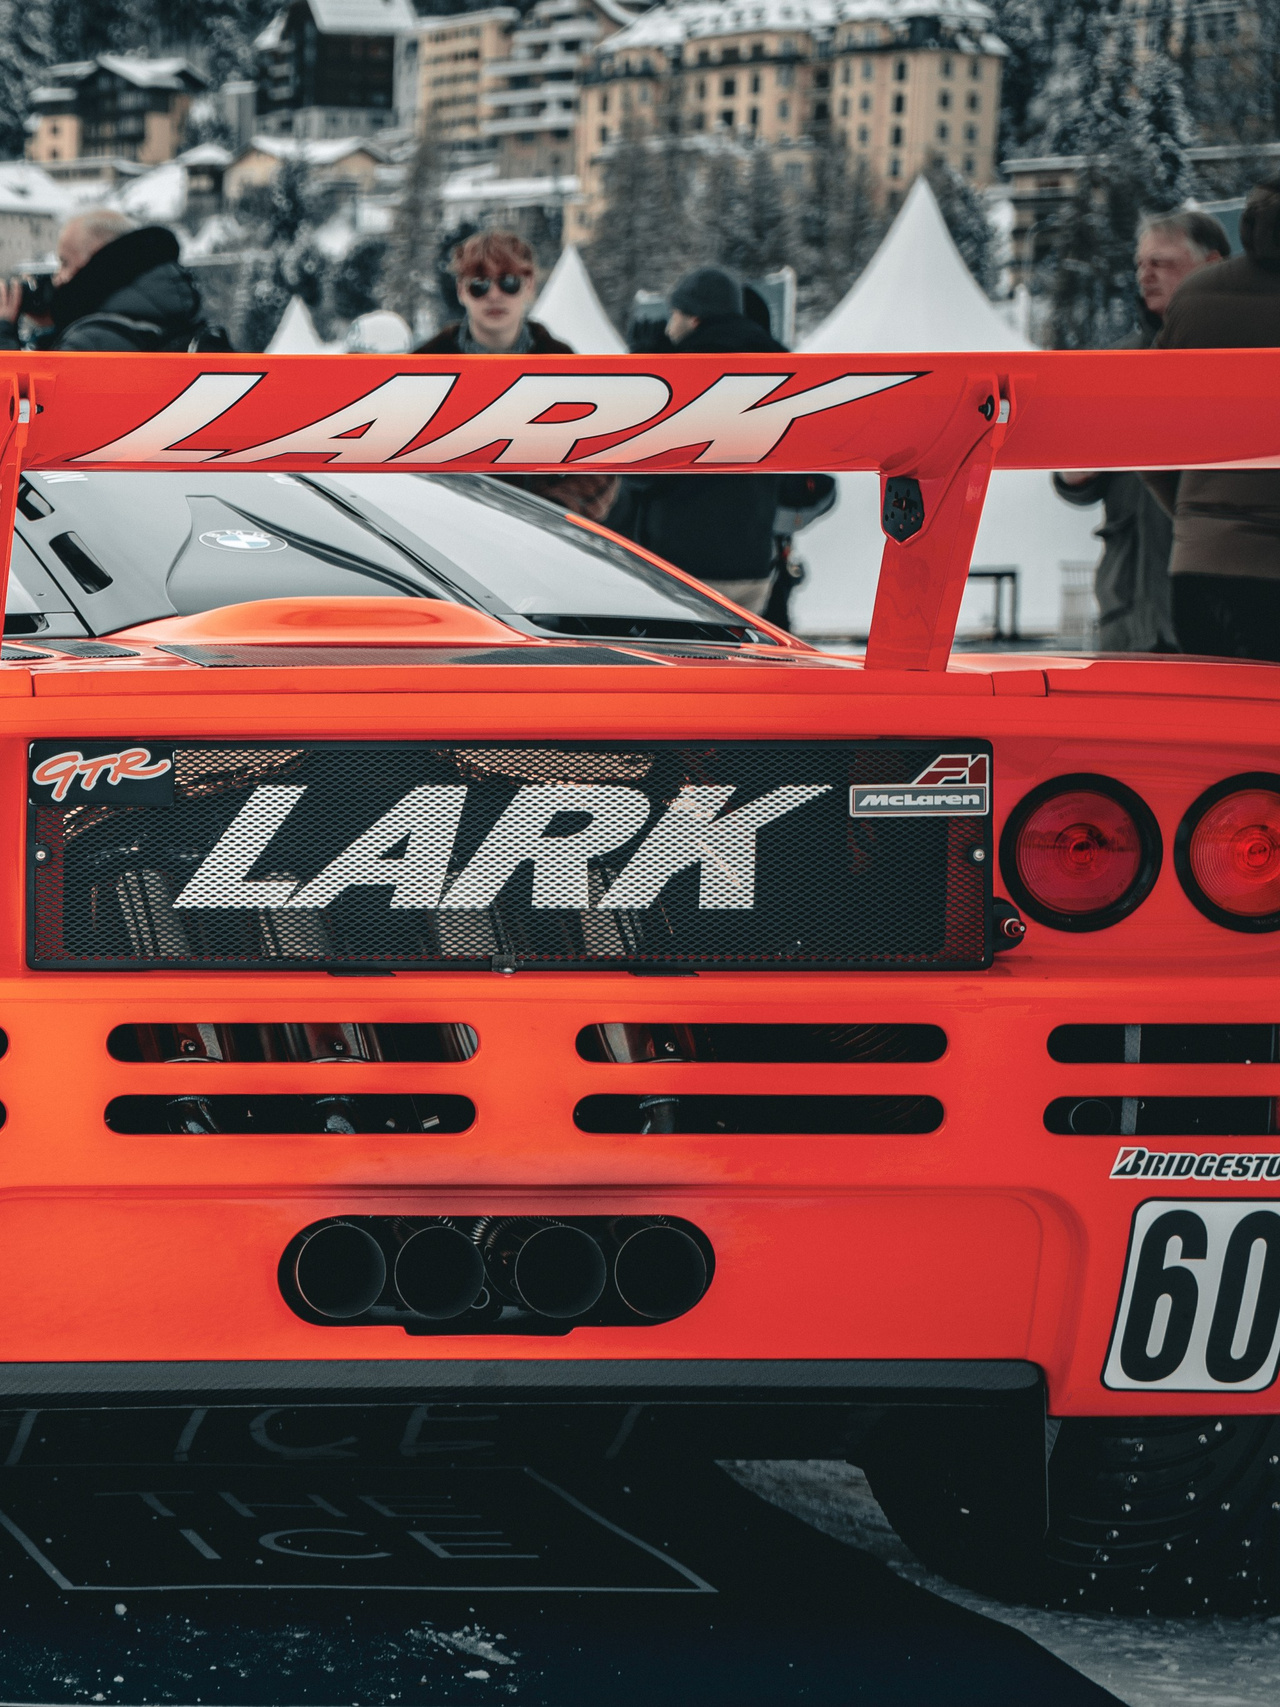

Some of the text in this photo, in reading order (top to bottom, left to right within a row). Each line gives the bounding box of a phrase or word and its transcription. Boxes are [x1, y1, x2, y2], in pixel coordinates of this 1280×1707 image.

[62, 371, 932, 465] LARK
[32, 748, 172, 802] GTR
[859, 793, 980, 807] McLaren
[172, 783, 833, 909] LARK
[1120, 1209, 1280, 1384] 60
[94, 1490, 483, 1518] THE
[179, 1528, 541, 1559] ICE
